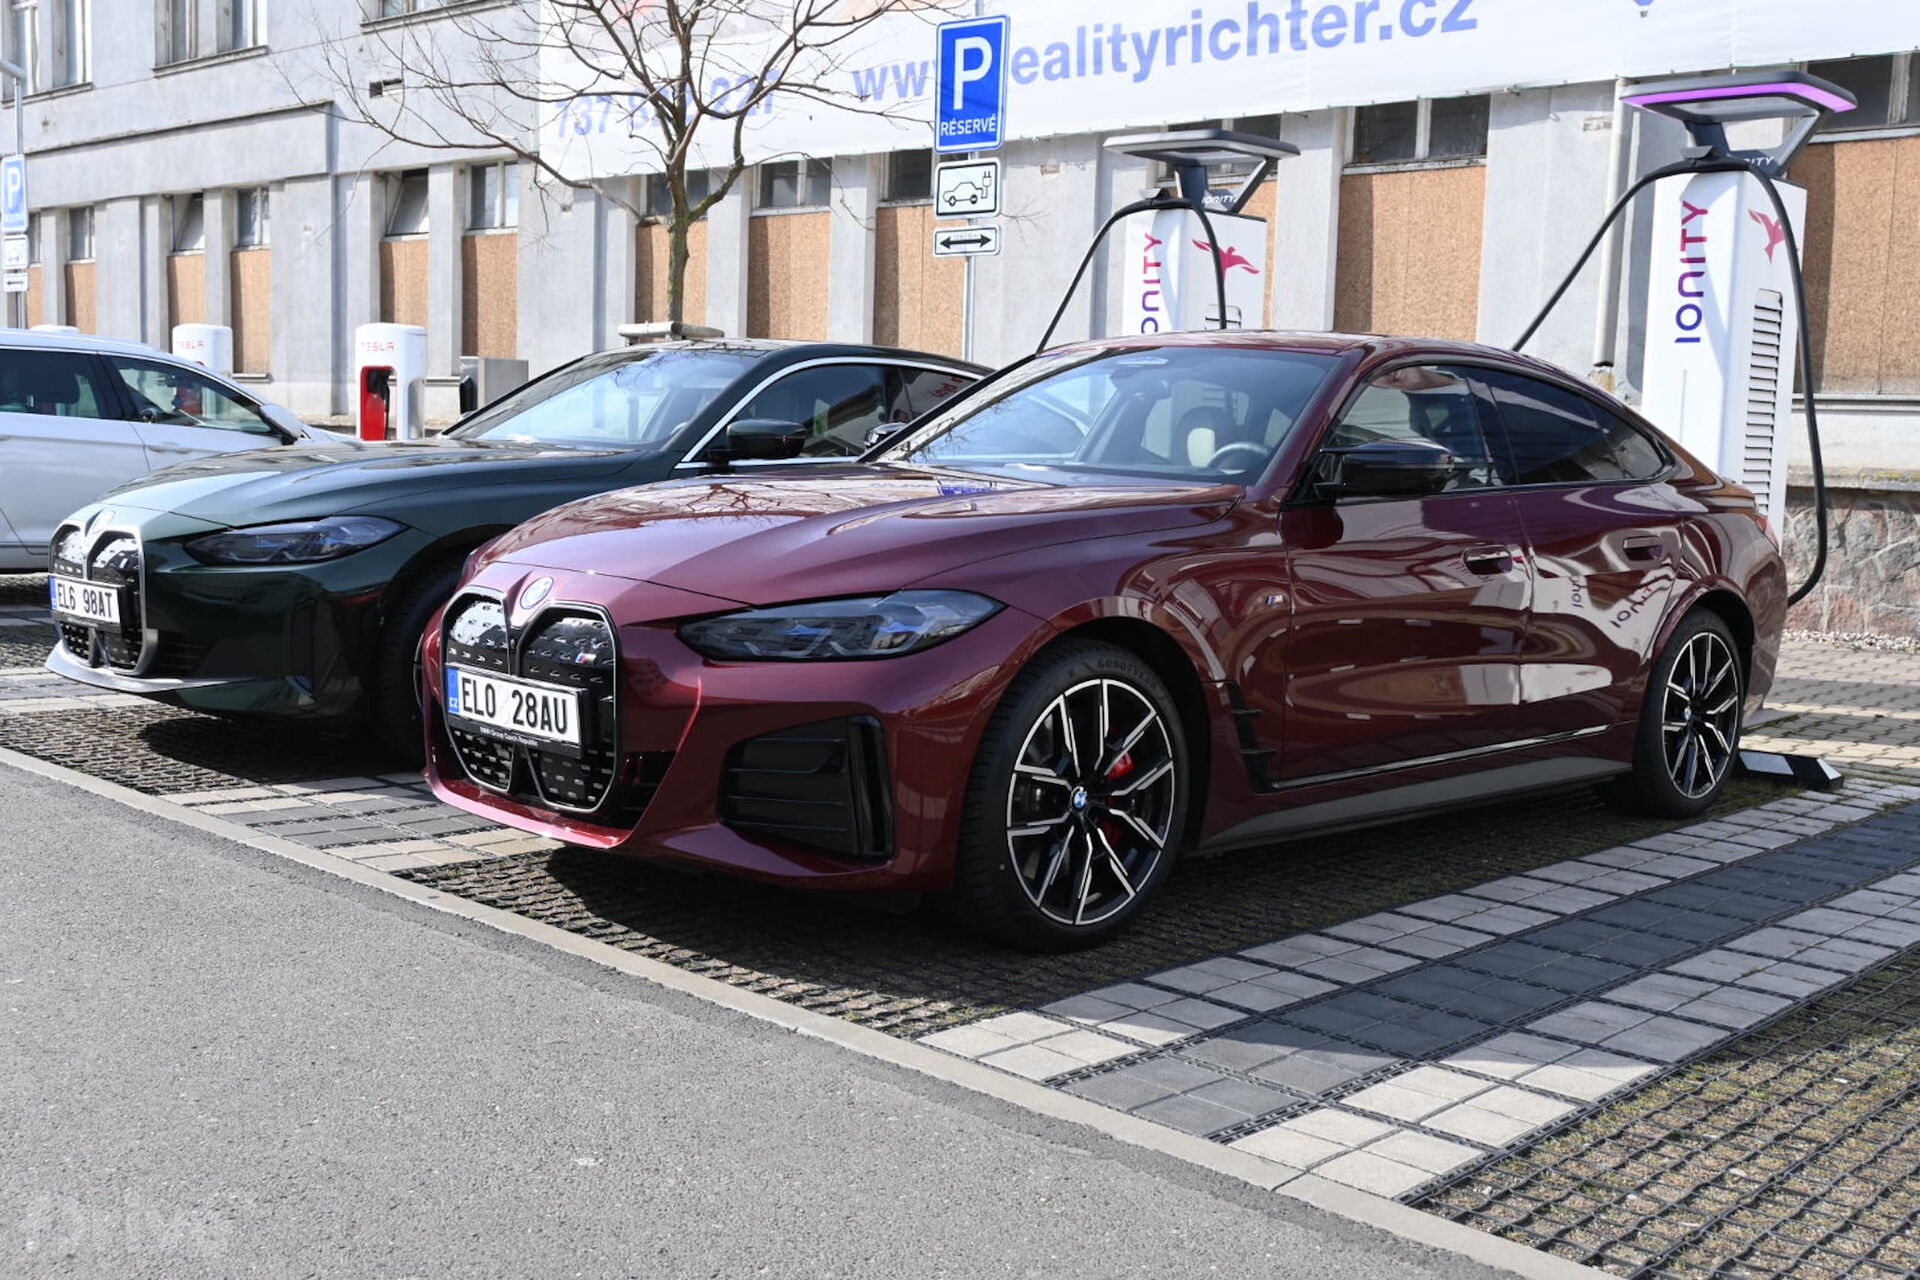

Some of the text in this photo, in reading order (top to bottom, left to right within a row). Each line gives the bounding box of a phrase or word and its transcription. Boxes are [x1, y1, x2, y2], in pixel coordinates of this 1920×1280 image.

[953, 36, 993, 110] P
[940, 113, 997, 137] RÉSERVÉ
[7, 167, 21, 208] P
[1141, 232, 1162, 334] ONITY
[1675, 200, 1709, 343] IONITY
[57, 583, 112, 618] EL6 98AT
[512, 689, 567, 734] 28AU
